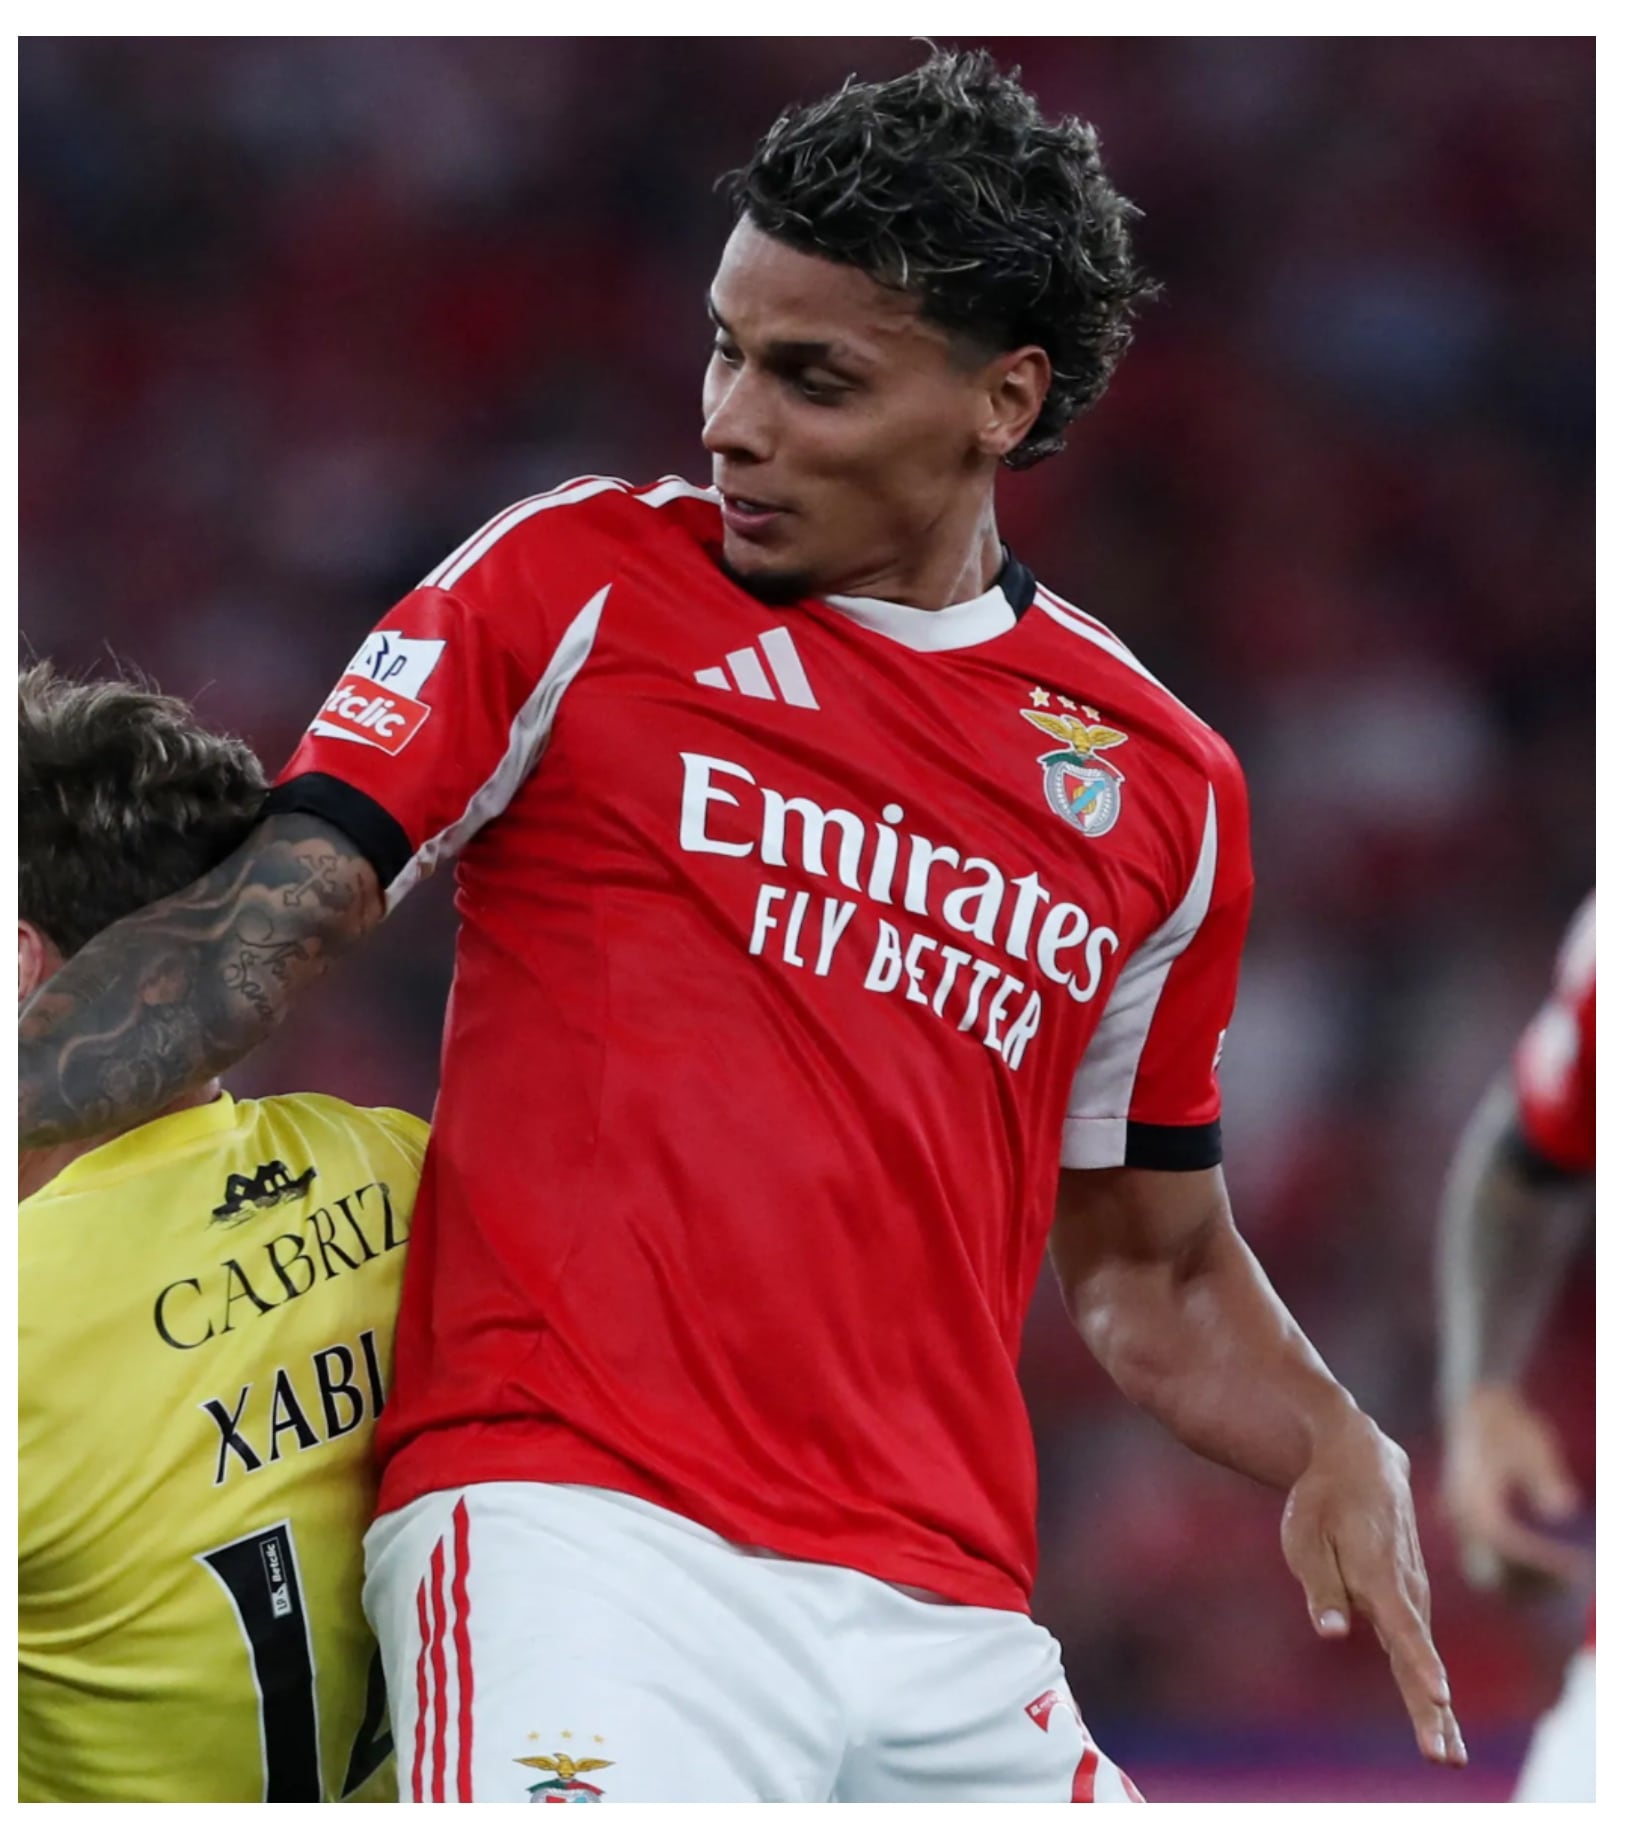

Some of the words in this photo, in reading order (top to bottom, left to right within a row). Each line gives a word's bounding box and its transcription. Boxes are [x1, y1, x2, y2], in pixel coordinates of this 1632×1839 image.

[679, 752, 1119, 1003] Emirates
[749, 884, 858, 977] FLY
[863, 918, 1042, 1071] BETTER
[153, 1182, 410, 1350] CABRIZ
[200, 1328, 388, 1486] XABI
